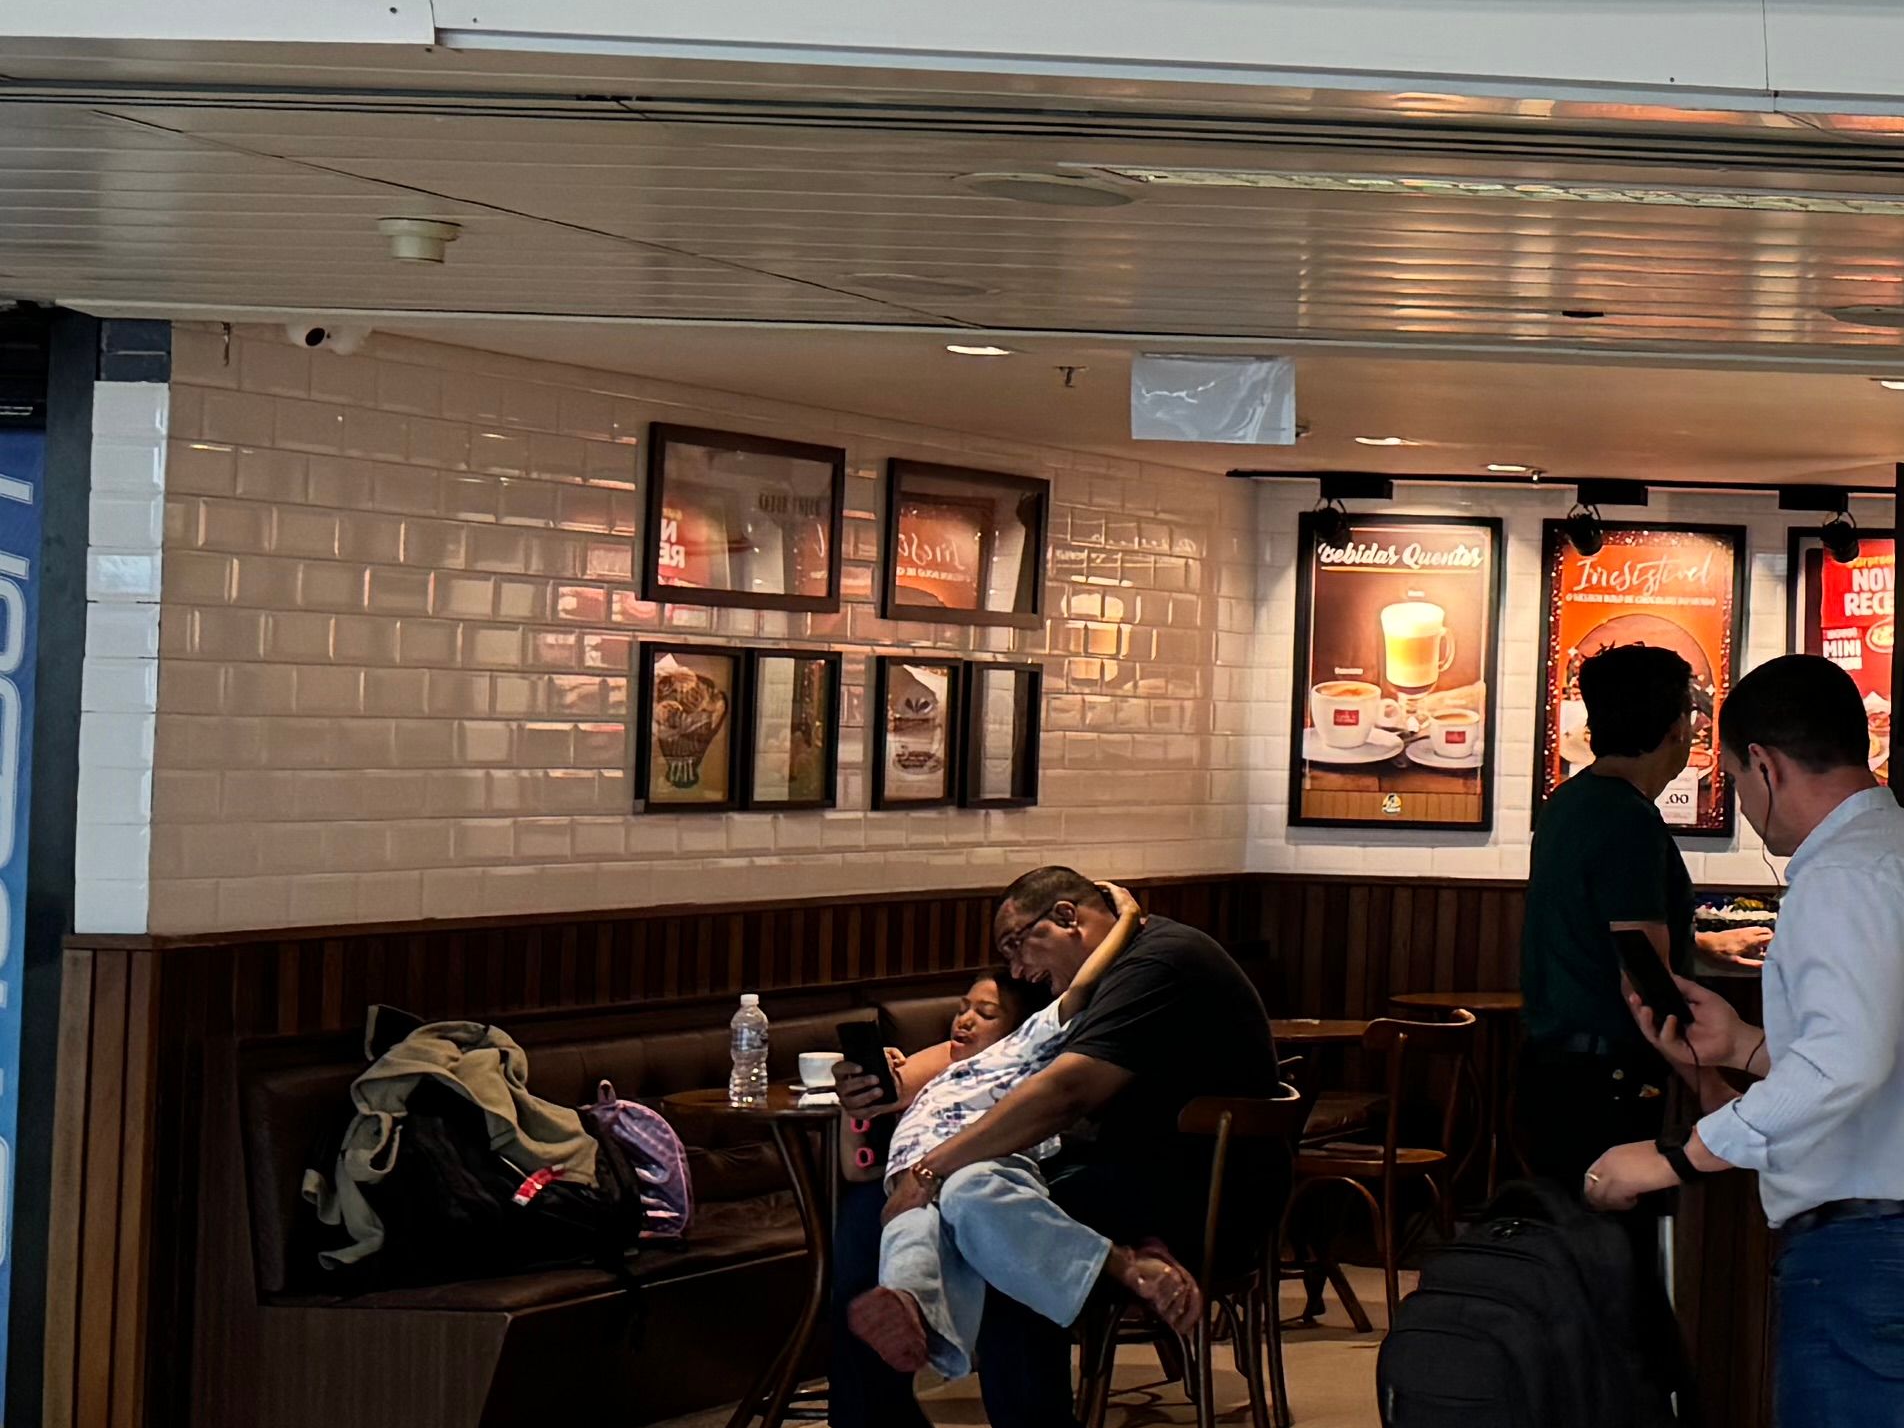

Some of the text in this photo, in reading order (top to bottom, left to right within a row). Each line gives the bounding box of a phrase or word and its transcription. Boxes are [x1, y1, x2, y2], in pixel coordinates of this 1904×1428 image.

[1402, 542, 1483, 569] Quentes
[1852, 568, 1895, 592] NOV
[1843, 591, 1895, 617] RECE
[1822, 638, 1862, 658] MINI
